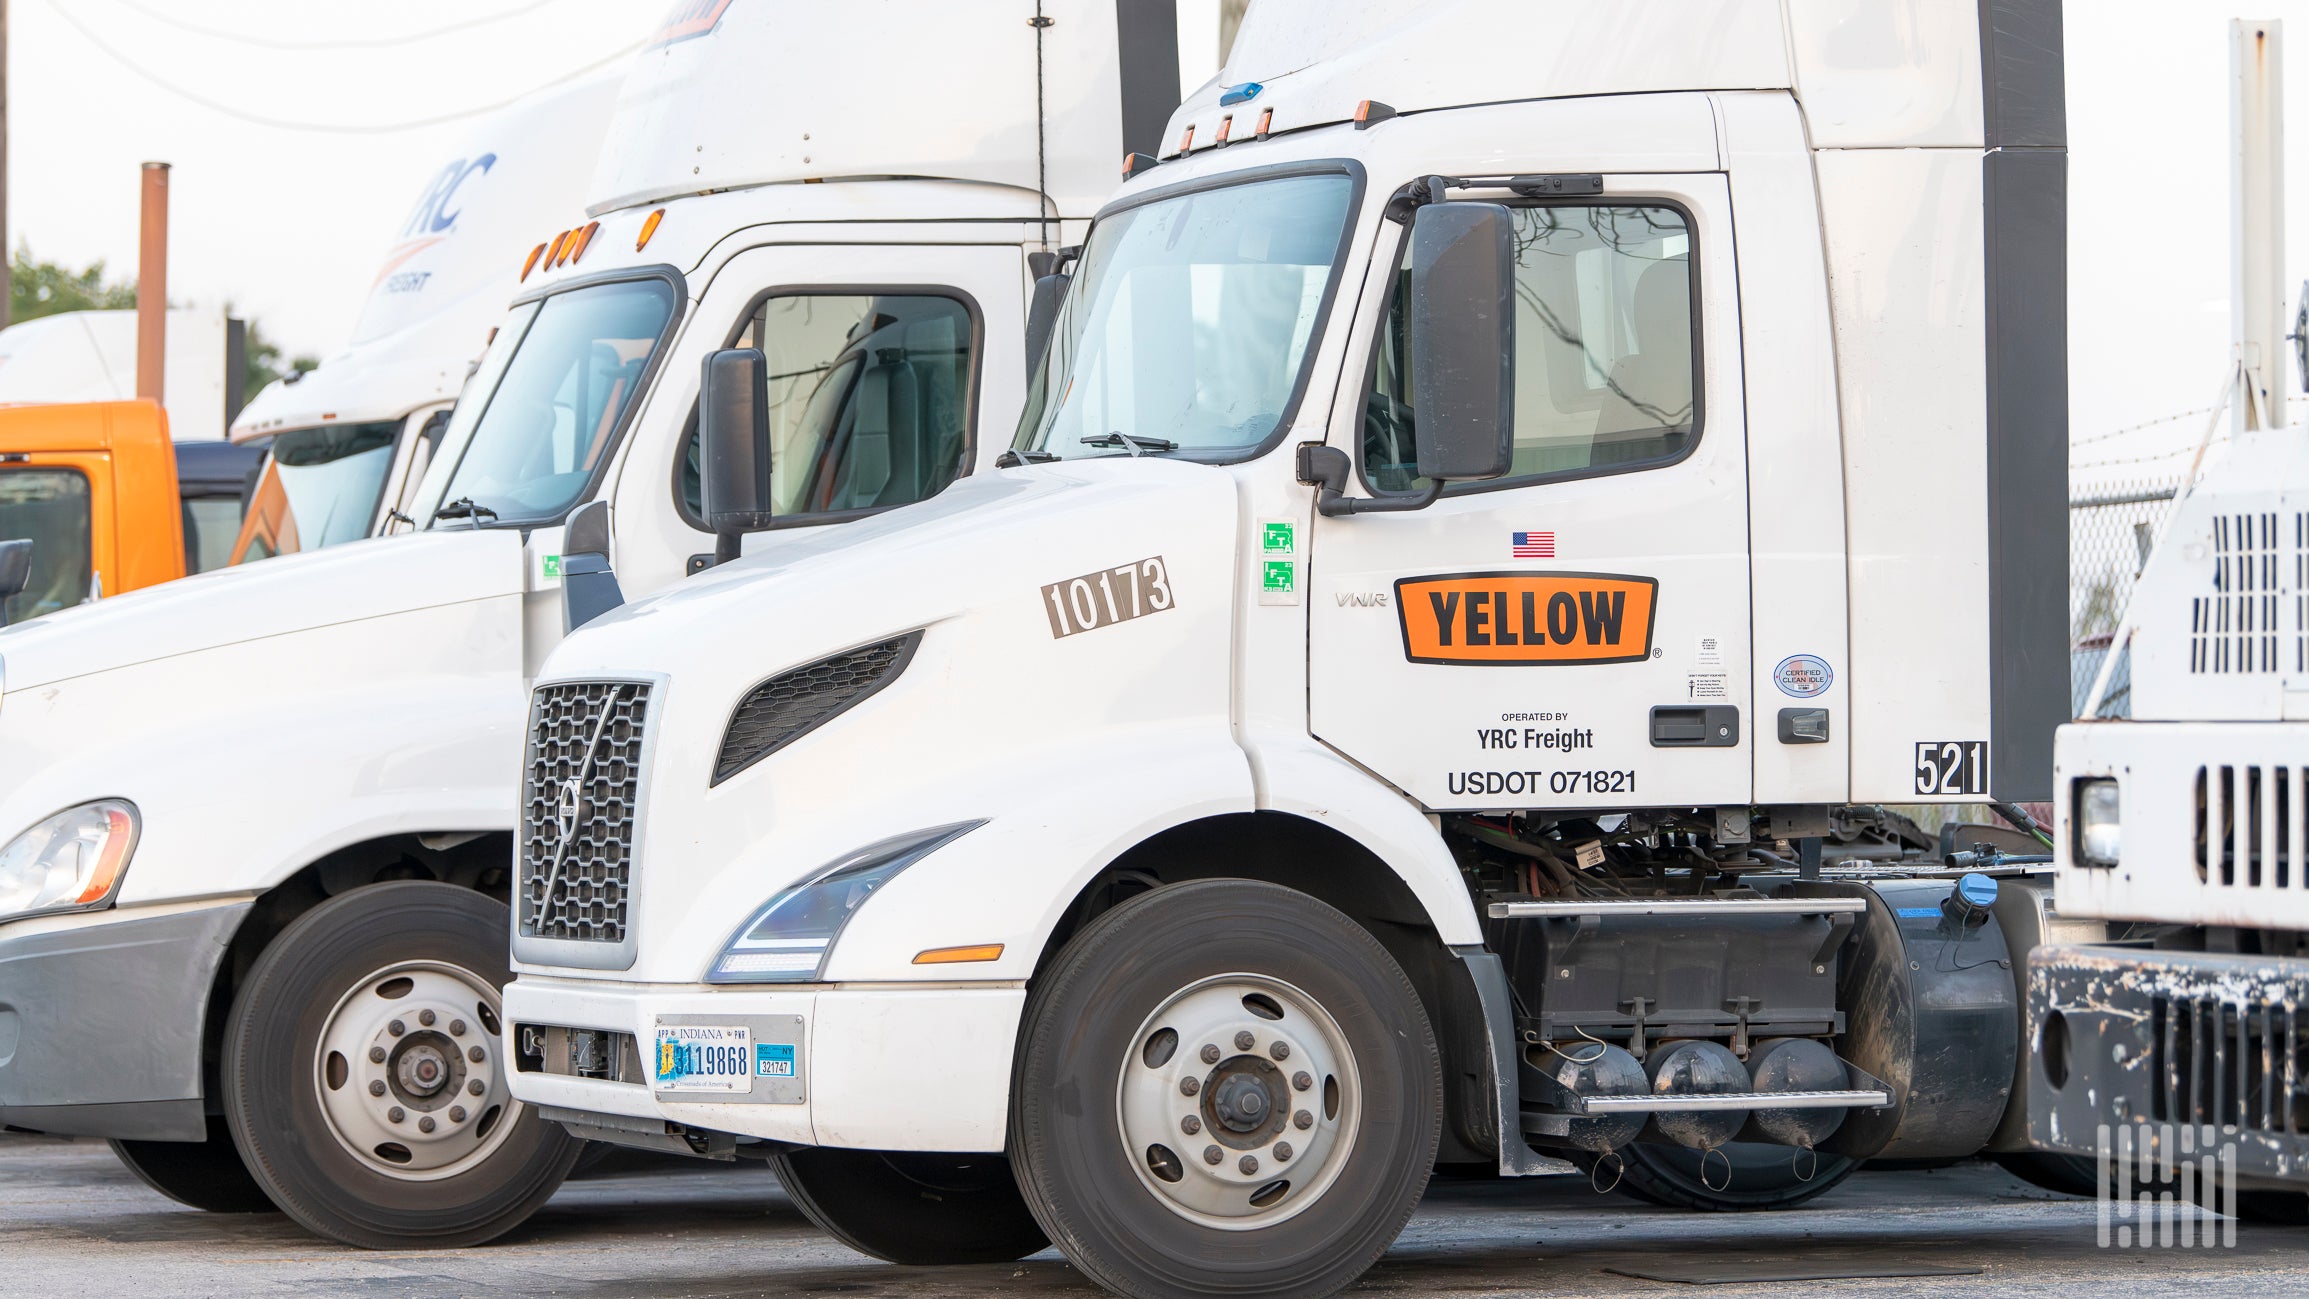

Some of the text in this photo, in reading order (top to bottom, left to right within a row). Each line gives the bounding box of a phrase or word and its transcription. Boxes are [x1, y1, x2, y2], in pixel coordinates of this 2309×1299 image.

[1050, 558, 1171, 636] 10173
[1335, 592, 1388, 607] VNR
[1428, 591, 1627, 646] YELLOW
[1501, 713, 1568, 722] OPERATED BY
[1477, 728, 1593, 753] YRC Freight
[1916, 742, 1981, 794] 521
[1448, 770, 1635, 795] USDOT 071821
[680, 1028, 723, 1040] INDIANA
[734, 1029, 746, 1040] PWR
[782, 1046, 793, 1055] NY
[675, 1046, 747, 1076] 3119868
[762, 1061, 788, 1075] 321747
